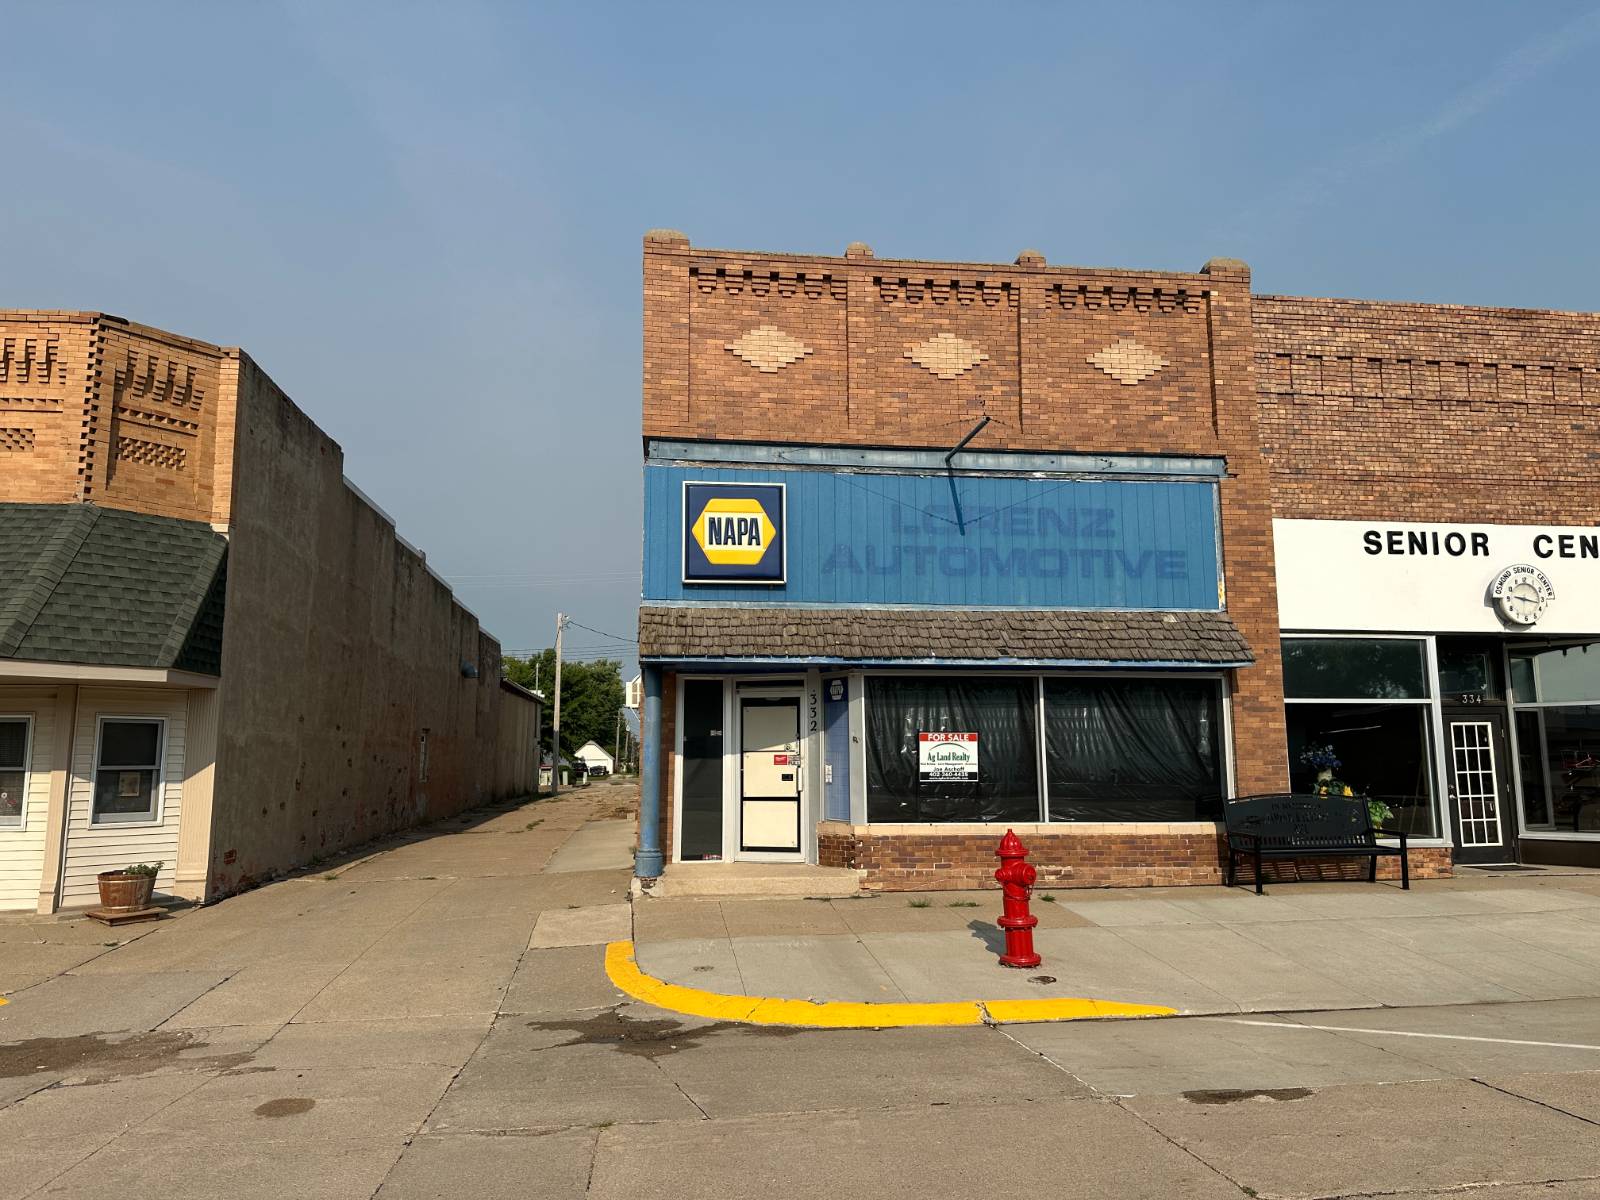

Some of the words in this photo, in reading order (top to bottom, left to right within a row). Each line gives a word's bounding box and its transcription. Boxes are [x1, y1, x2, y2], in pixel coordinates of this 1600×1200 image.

[708, 516, 761, 546] NAPA
[892, 503, 1115, 538] LORENZ
[1363, 530, 1490, 557] SENIOR
[1533, 534, 1600, 559] CEN
[822, 543, 1188, 580] AUTOMOTIVE
[1495, 570, 1512, 595] OSMOND
[1512, 566, 1535, 575] SENIOR
[1536, 573, 1553, 597] CENTER
[809, 693, 818, 732] 332
[1462, 694, 1481, 704] 334
[928, 733, 946, 741] FOR
[948, 733, 969, 741] SALE
[927, 752, 936, 762] Ag
[937, 752, 951, 761] Land
[952, 752, 970, 762] Realty
